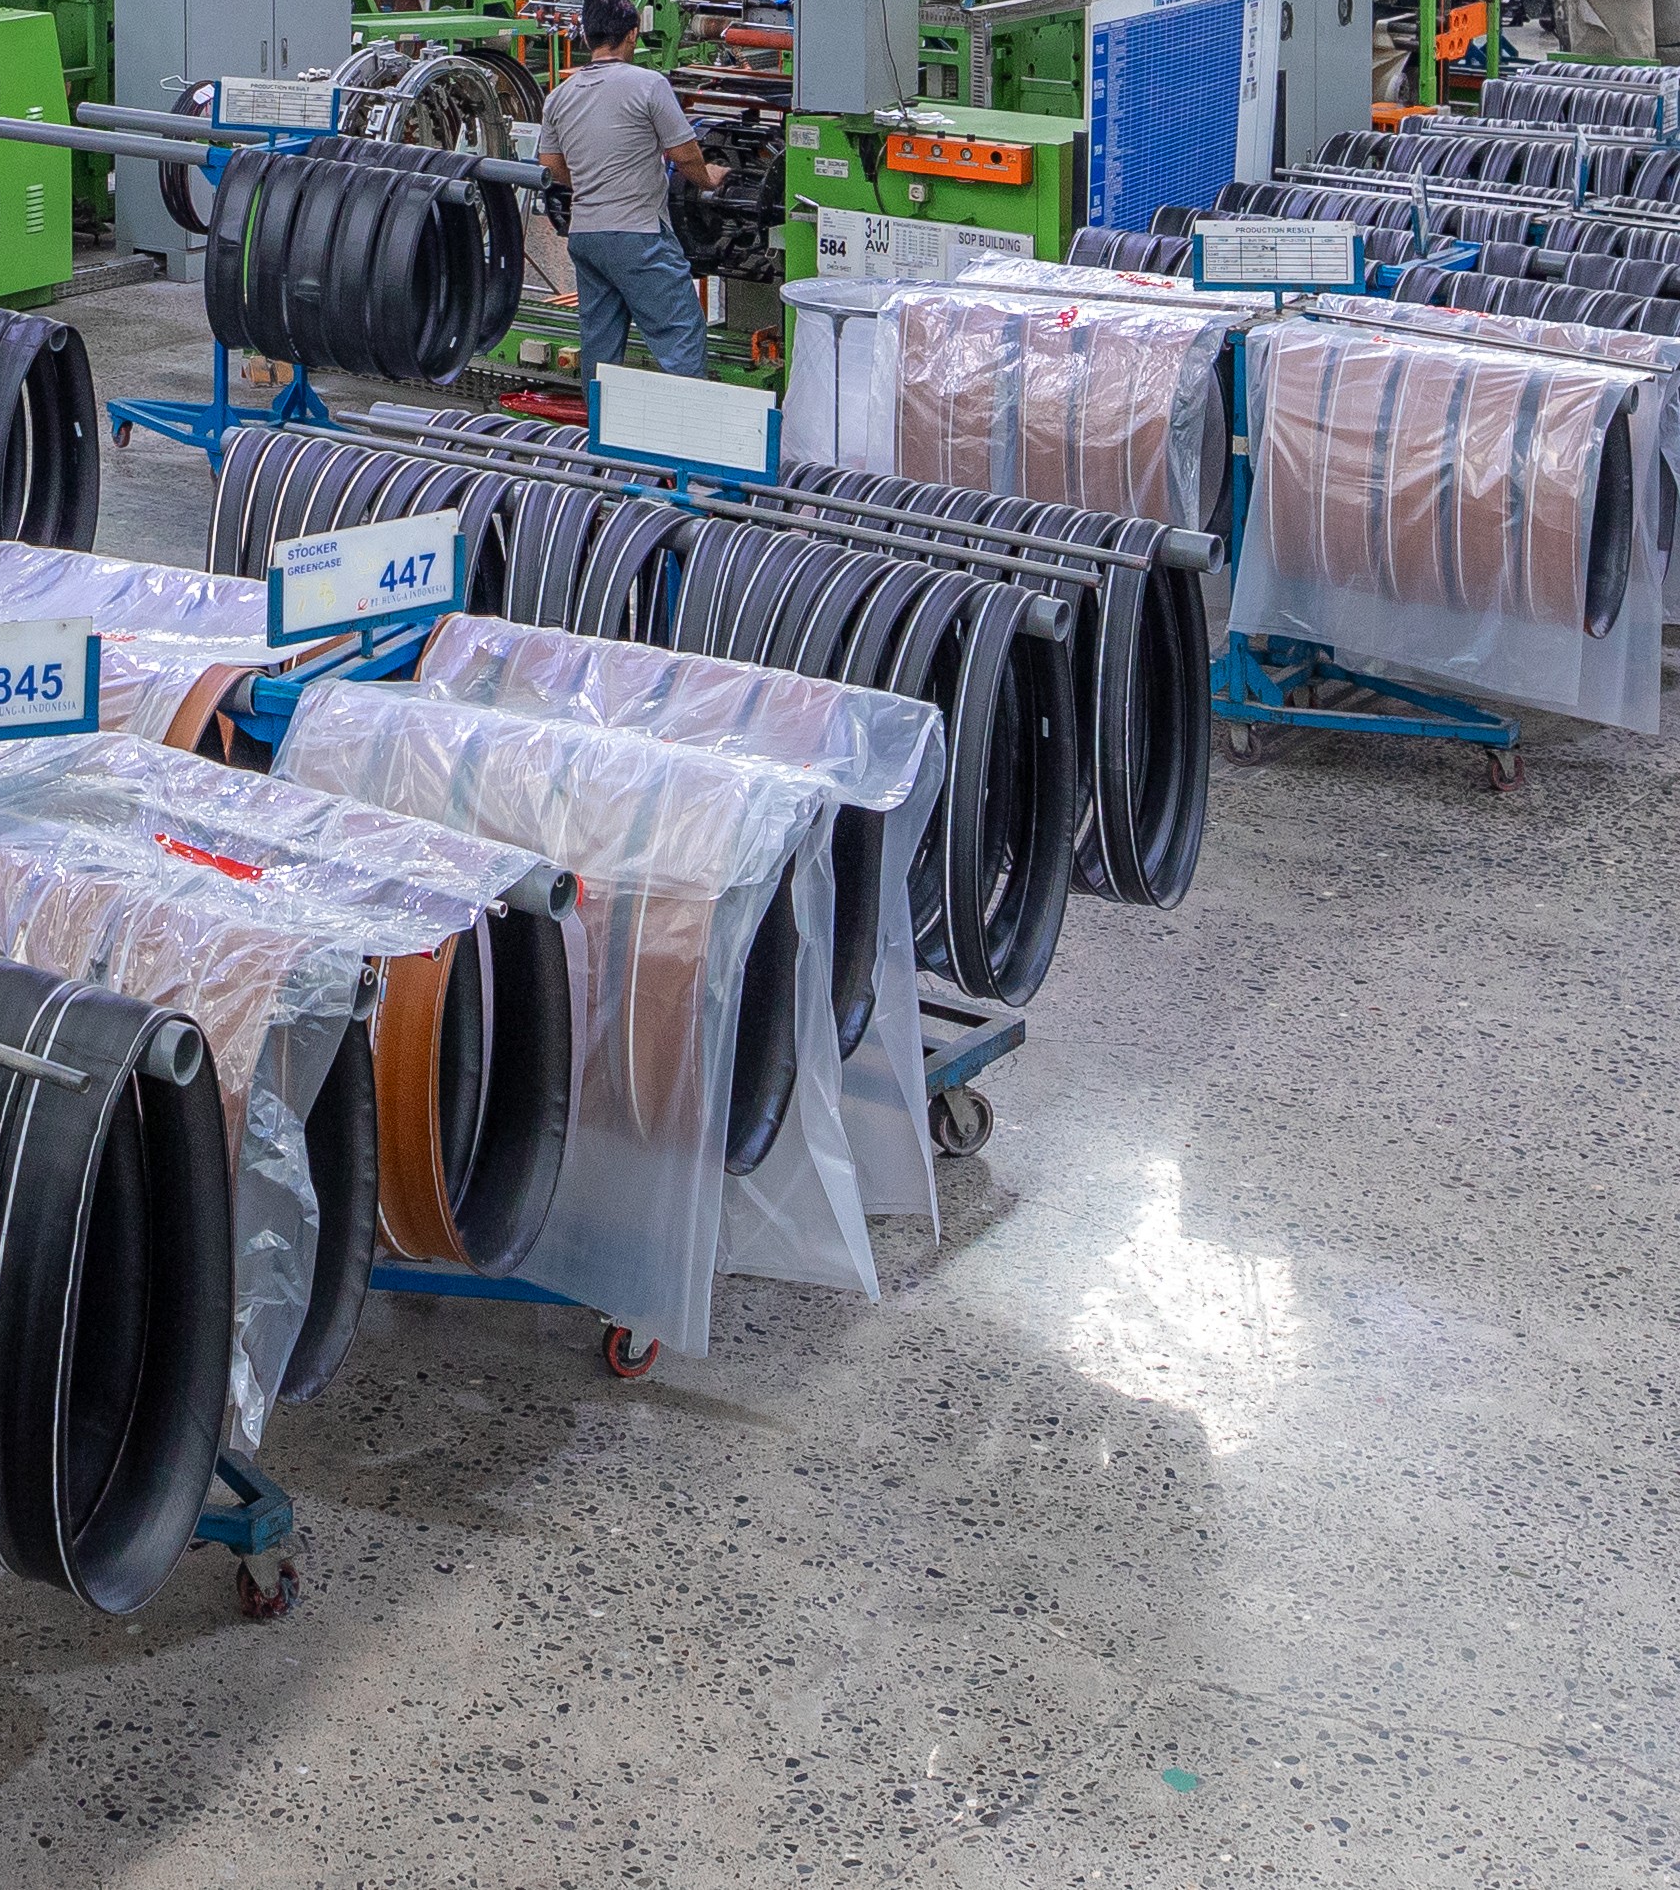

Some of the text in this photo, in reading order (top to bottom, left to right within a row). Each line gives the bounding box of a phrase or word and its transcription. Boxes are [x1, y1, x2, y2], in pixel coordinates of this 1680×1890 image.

[865, 217, 889, 242] 3-11
[820, 238, 846, 257] 584
[864, 239, 889, 254] AW
[959, 232, 977, 246] SOP
[978, 235, 1021, 252] BUILDING
[287, 541, 338, 561] STOCKER
[287, 557, 342, 577] GREENCASE
[380, 552, 436, 592] 447
[409, 586, 447, 600] INDONESIA
[28, 700, 77, 714] INDONESIA
